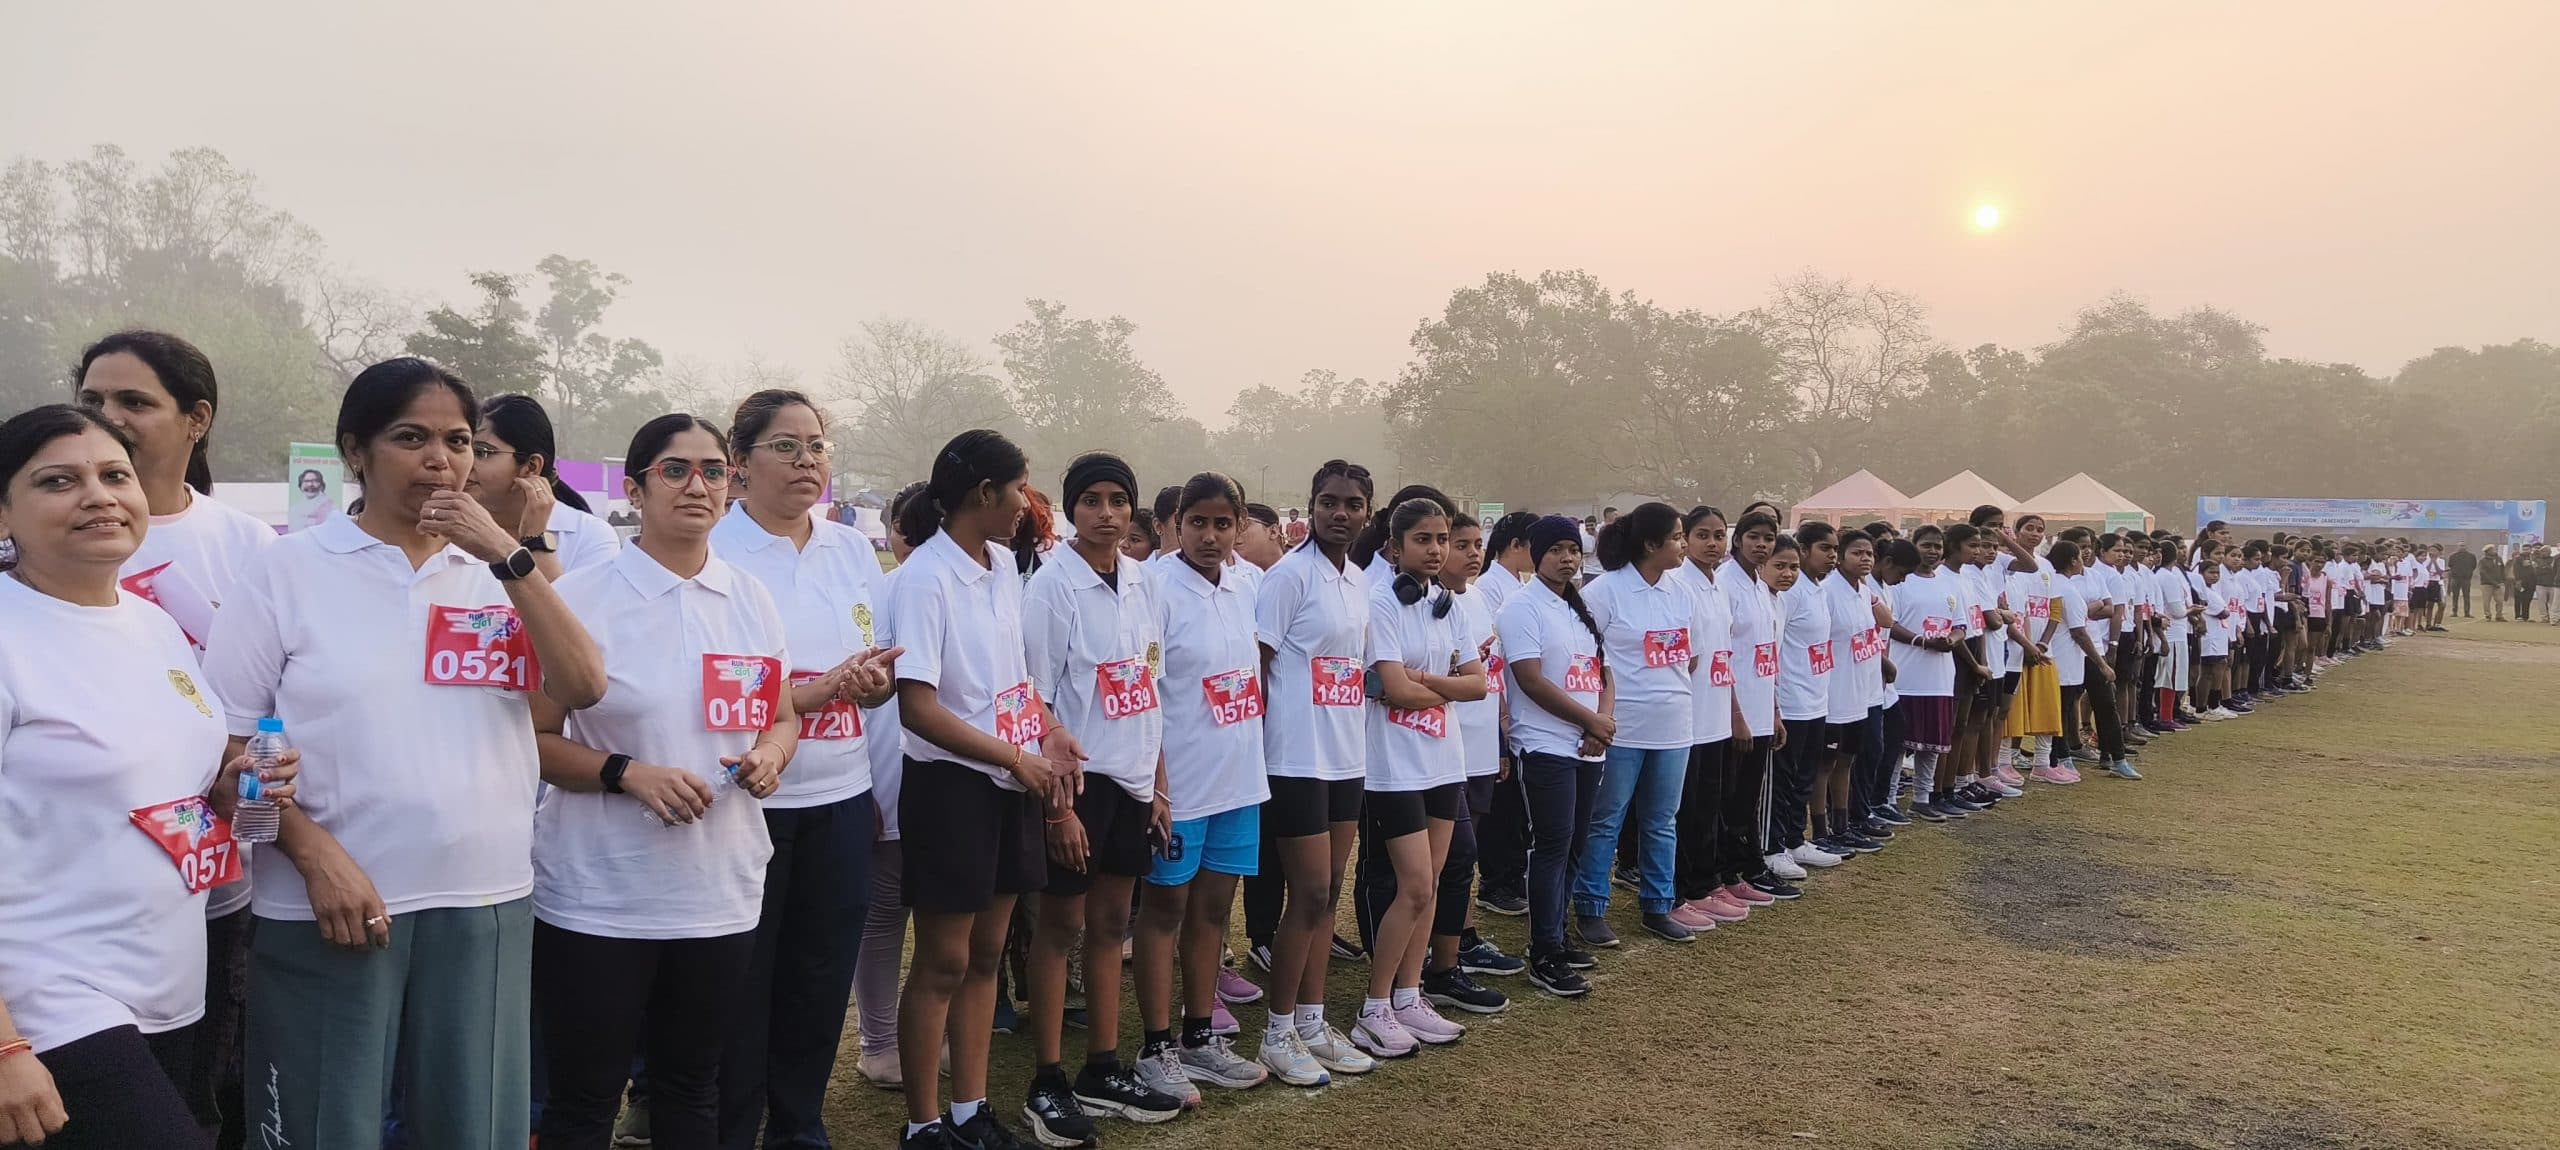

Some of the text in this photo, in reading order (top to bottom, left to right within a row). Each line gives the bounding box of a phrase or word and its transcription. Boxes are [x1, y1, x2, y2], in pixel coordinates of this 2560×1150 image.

[432, 649, 526, 686] 0521
[1649, 649, 1689, 665] 1153
[1317, 684, 1361, 704] 1420
[1567, 674, 1601, 690] 0116
[709, 698, 768, 727] 0153
[1105, 687, 1151, 715] 0339
[1212, 695, 1259, 725] 0575
[796, 711, 854, 737] 720
[1394, 709, 1442, 736] 1444
[180, 841, 231, 889] 057
[1305, 1012, 1320, 1021] ck
